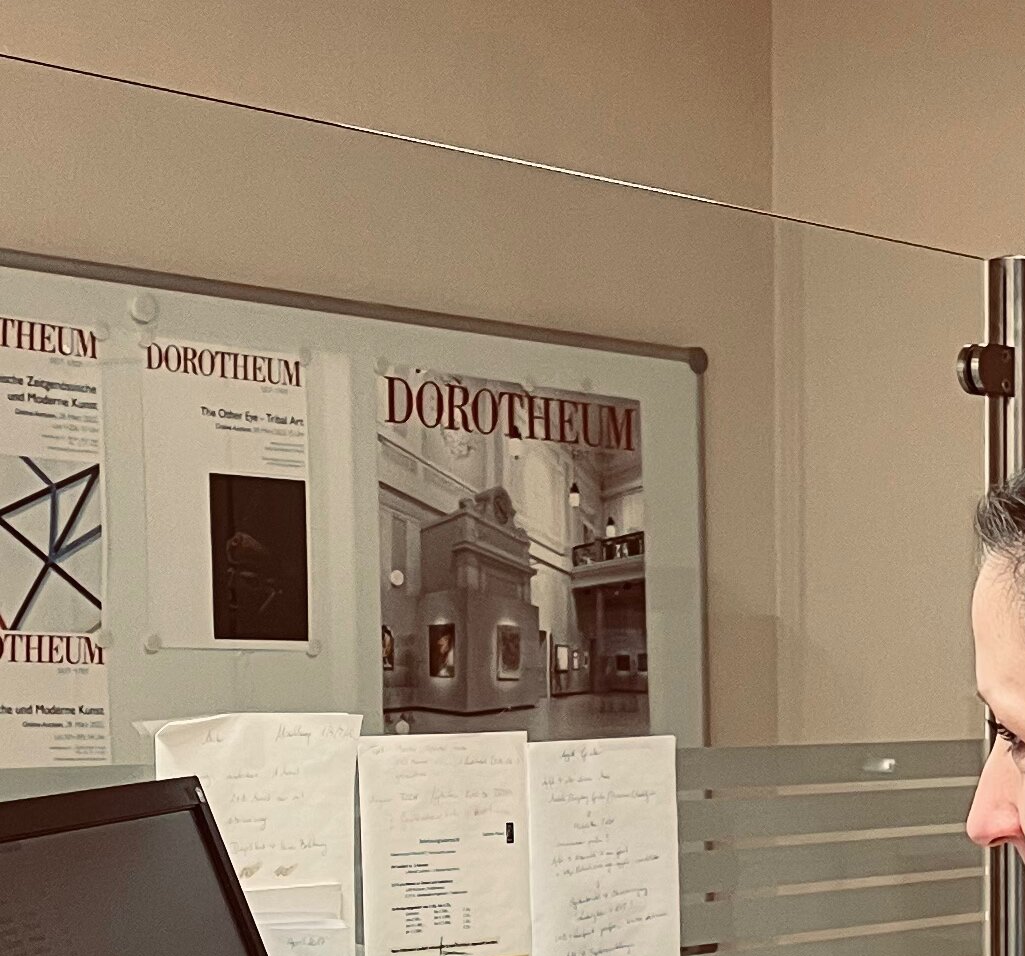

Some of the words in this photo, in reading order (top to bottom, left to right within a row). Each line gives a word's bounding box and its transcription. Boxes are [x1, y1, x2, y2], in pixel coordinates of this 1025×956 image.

[146, 342, 302, 387] DOROTHEUM
[200, 405, 217, 418] The
[218, 408, 243, 421] Other
[245, 411, 259, 424] Eye
[383, 375, 637, 451] DOROTHEUM
[15, 705, 33, 715] und
[35, 704, 76, 715] Moderne
[78, 704, 105, 716] Kunst
